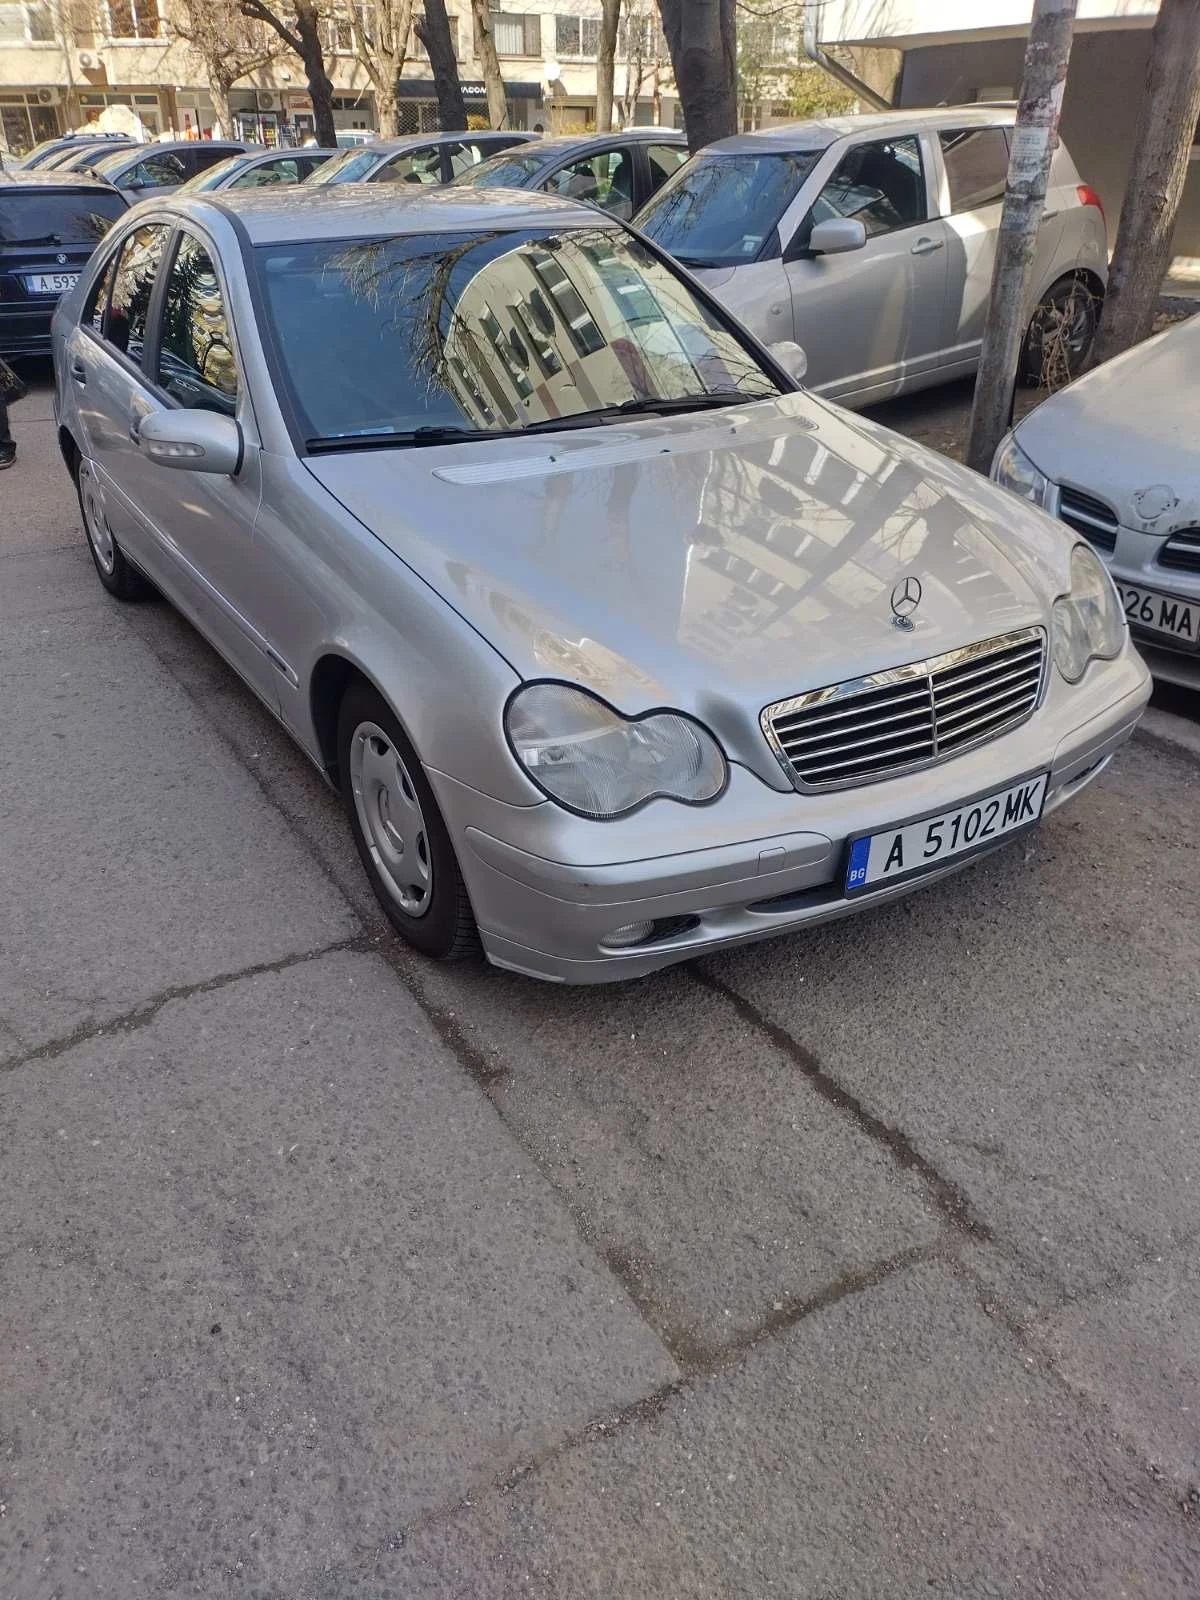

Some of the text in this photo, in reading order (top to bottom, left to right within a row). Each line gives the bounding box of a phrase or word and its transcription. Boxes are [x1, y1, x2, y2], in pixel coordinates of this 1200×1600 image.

[40, 275, 80, 290] A 593
[1158, 600, 1192, 636] MA
[883, 834, 904, 872] A
[850, 869, 865, 881] BG
